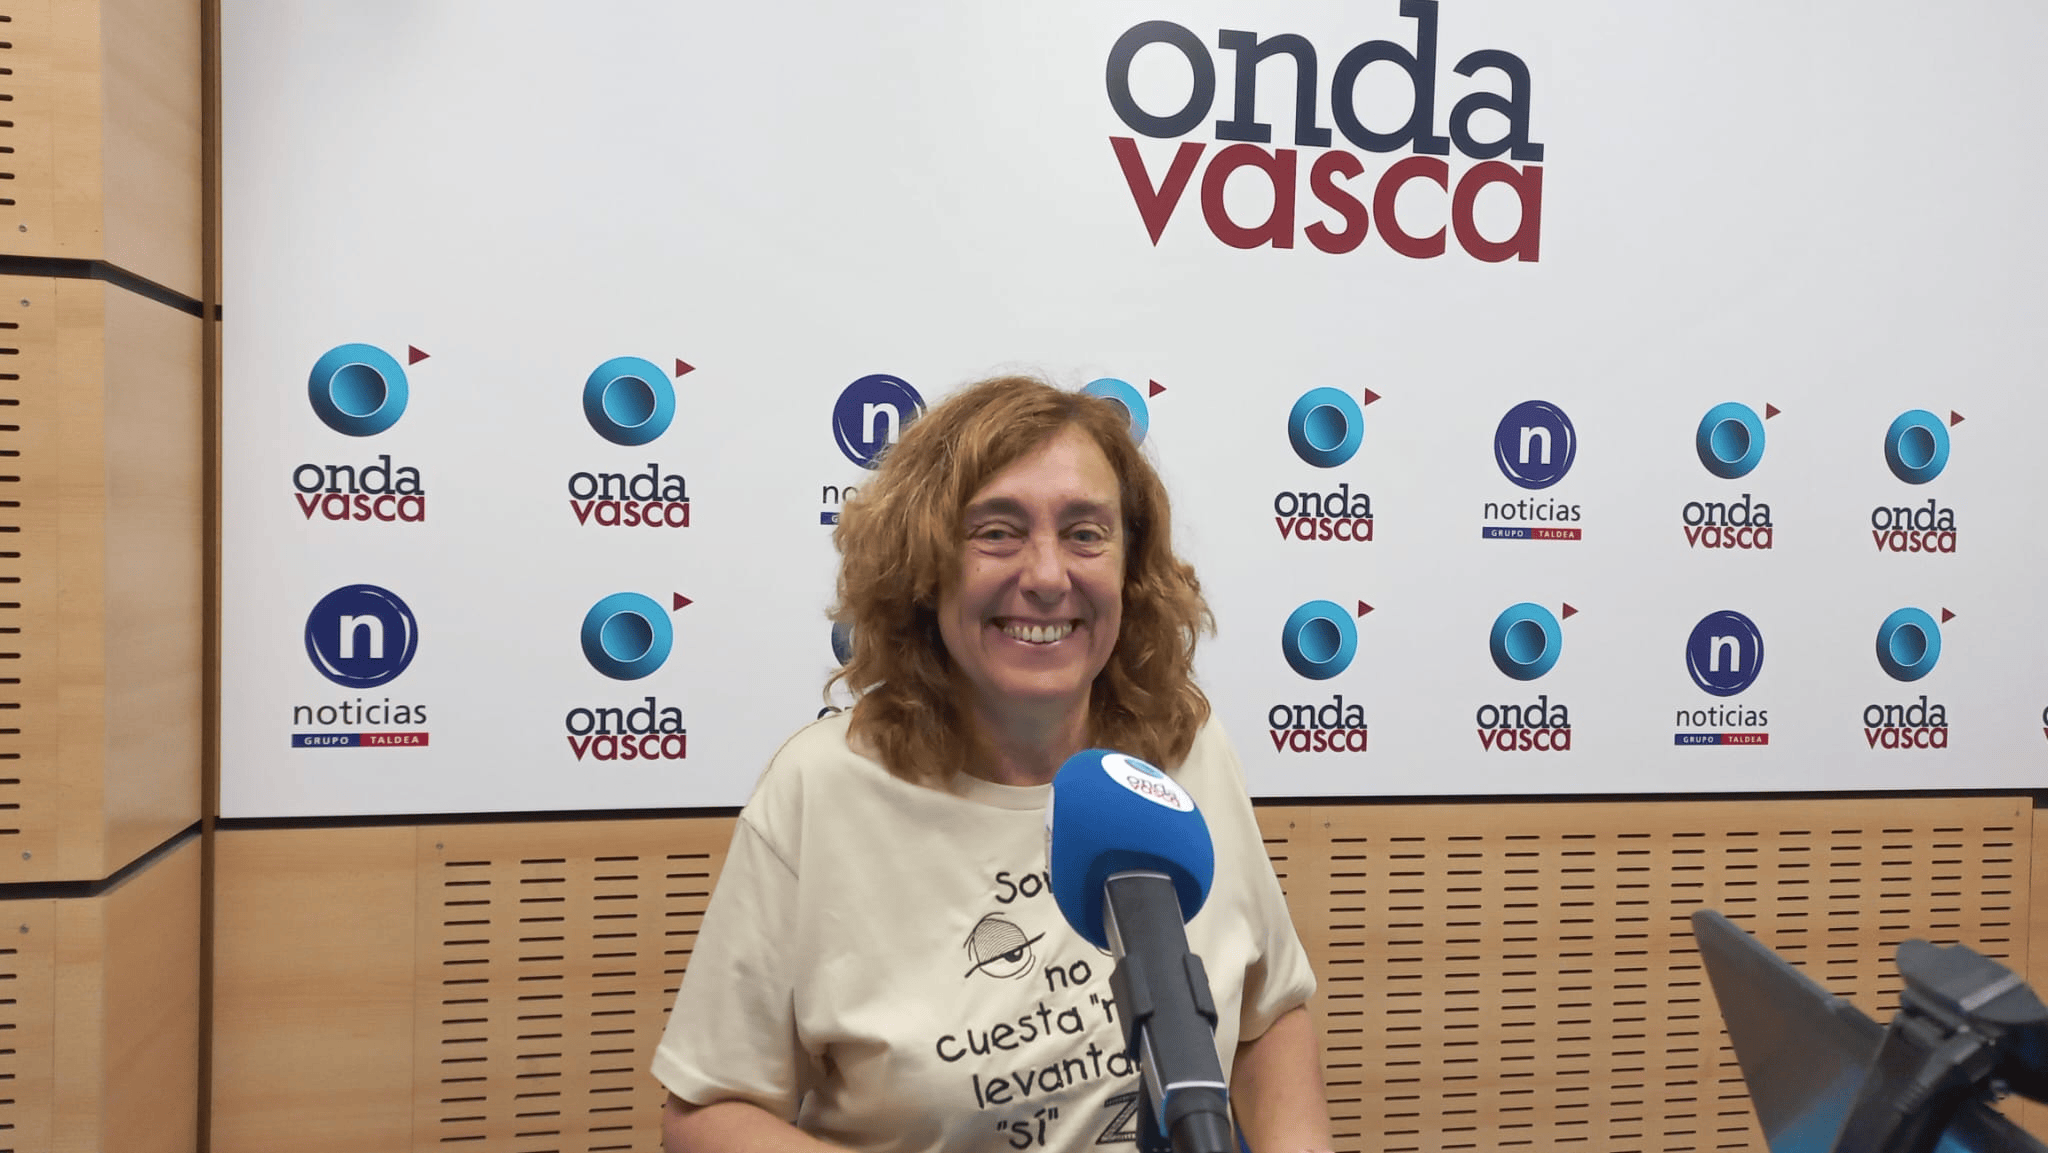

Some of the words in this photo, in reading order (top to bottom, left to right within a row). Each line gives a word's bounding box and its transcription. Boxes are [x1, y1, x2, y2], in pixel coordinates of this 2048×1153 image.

[1106, 0, 1544, 162] onda
[1109, 136, 1544, 263] vasca
[293, 455, 425, 495] onda
[568, 463, 690, 503] onda
[295, 492, 425, 522] vasca
[570, 499, 690, 528] vasca
[1274, 483, 1374, 519] onda
[1484, 497, 1581, 521] noticias
[1682, 493, 1773, 528] onda
[1871, 498, 1957, 532] onda
[1275, 515, 1374, 542] vasca
[1491, 529, 1524, 537] GRUPO
[1539, 530, 1575, 538] TALDEA
[1683, 524, 1773, 550] vasca
[1872, 528, 1957, 554] vasca
[293, 698, 427, 725] noticias
[565, 696, 687, 737] onda
[1268, 694, 1368, 731] onda
[1476, 694, 1571, 730] onda
[1676, 704, 1768, 727] noticias
[1863, 695, 1949, 729] onda
[304, 736, 350, 745] GRUPO
[370, 735, 420, 744] TALDEA
[567, 732, 687, 761] vasca
[1269, 727, 1368, 753] vasca
[1477, 727, 1571, 752] vasca
[1864, 725, 1948, 750] vasca
[995, 871, 1053, 904] So
[1045, 960, 1092, 992] no
[936, 1003, 1084, 1062] cuesta
[973, 1043, 1140, 1109] levanta
[997, 1107, 1060, 1150] "sí"
